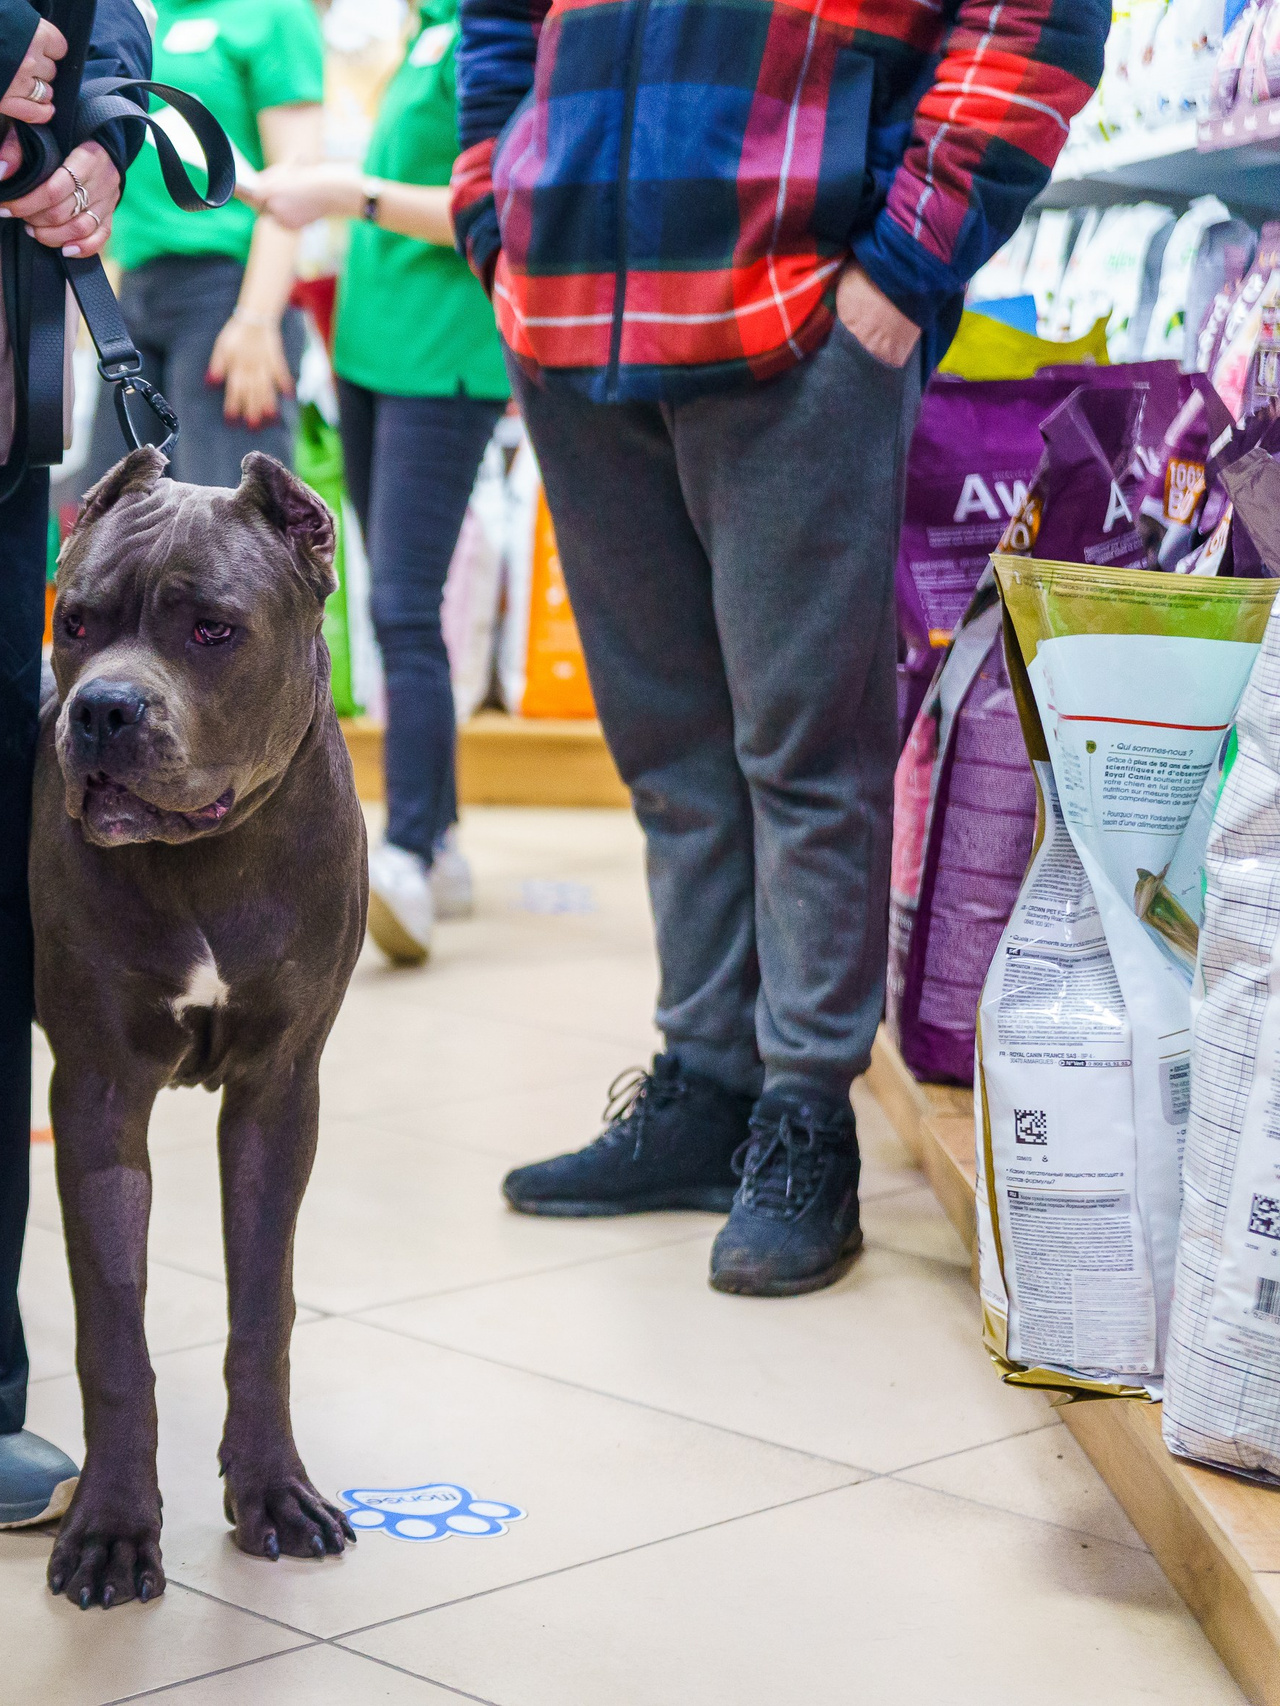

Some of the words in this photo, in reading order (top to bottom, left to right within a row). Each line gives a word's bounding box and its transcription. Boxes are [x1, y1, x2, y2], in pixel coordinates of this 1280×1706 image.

[1117, 742, 1131, 751] Qui
[1132, 745, 1187, 756] sommes-nous
[1133, 759, 1147, 767] plus
[1105, 764, 1154, 774] scientifiques
[1104, 771, 1125, 779] Royal
[1128, 773, 1151, 781] Canin
[1103, 786, 1130, 794] nutrition
[1143, 790, 1169, 798] mesure
[1118, 795, 1171, 806] compréhension
